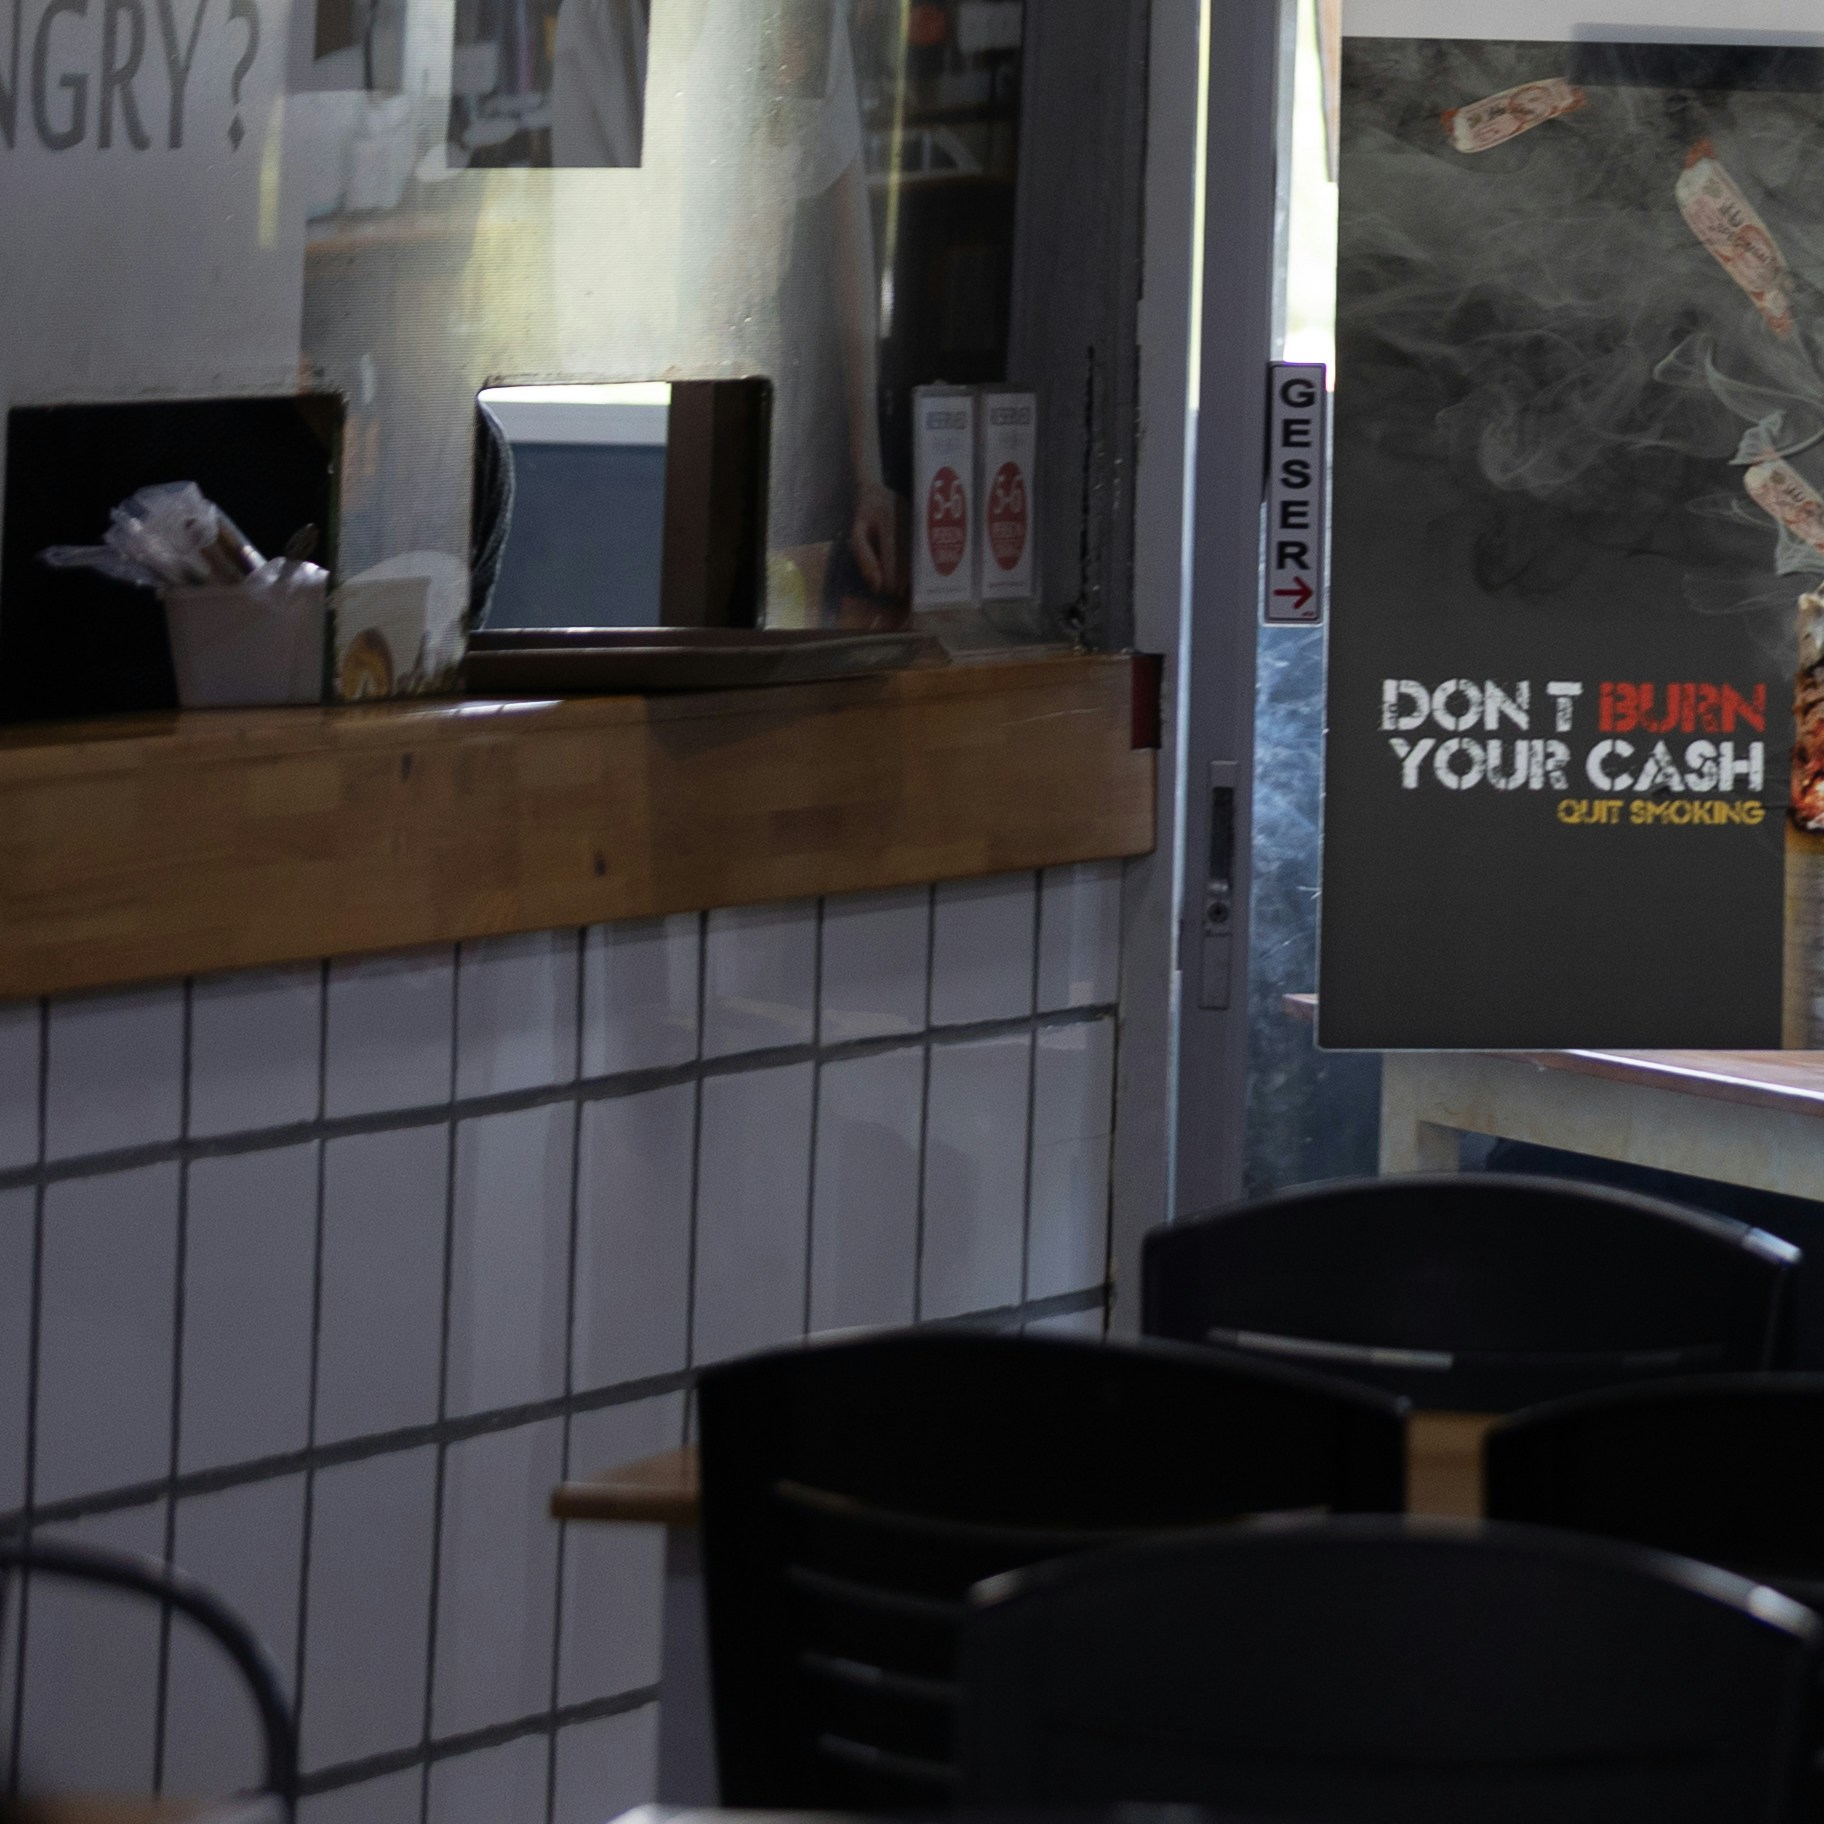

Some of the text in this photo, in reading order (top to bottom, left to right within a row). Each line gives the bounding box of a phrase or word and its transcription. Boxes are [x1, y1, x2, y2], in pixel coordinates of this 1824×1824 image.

[1276, 378, 1316, 570] GESER
[1598, 681, 1768, 734] BURN
[1388, 737, 1764, 792] YOUR CASH
[1556, 798, 1767, 825] QUIT SMOKING
